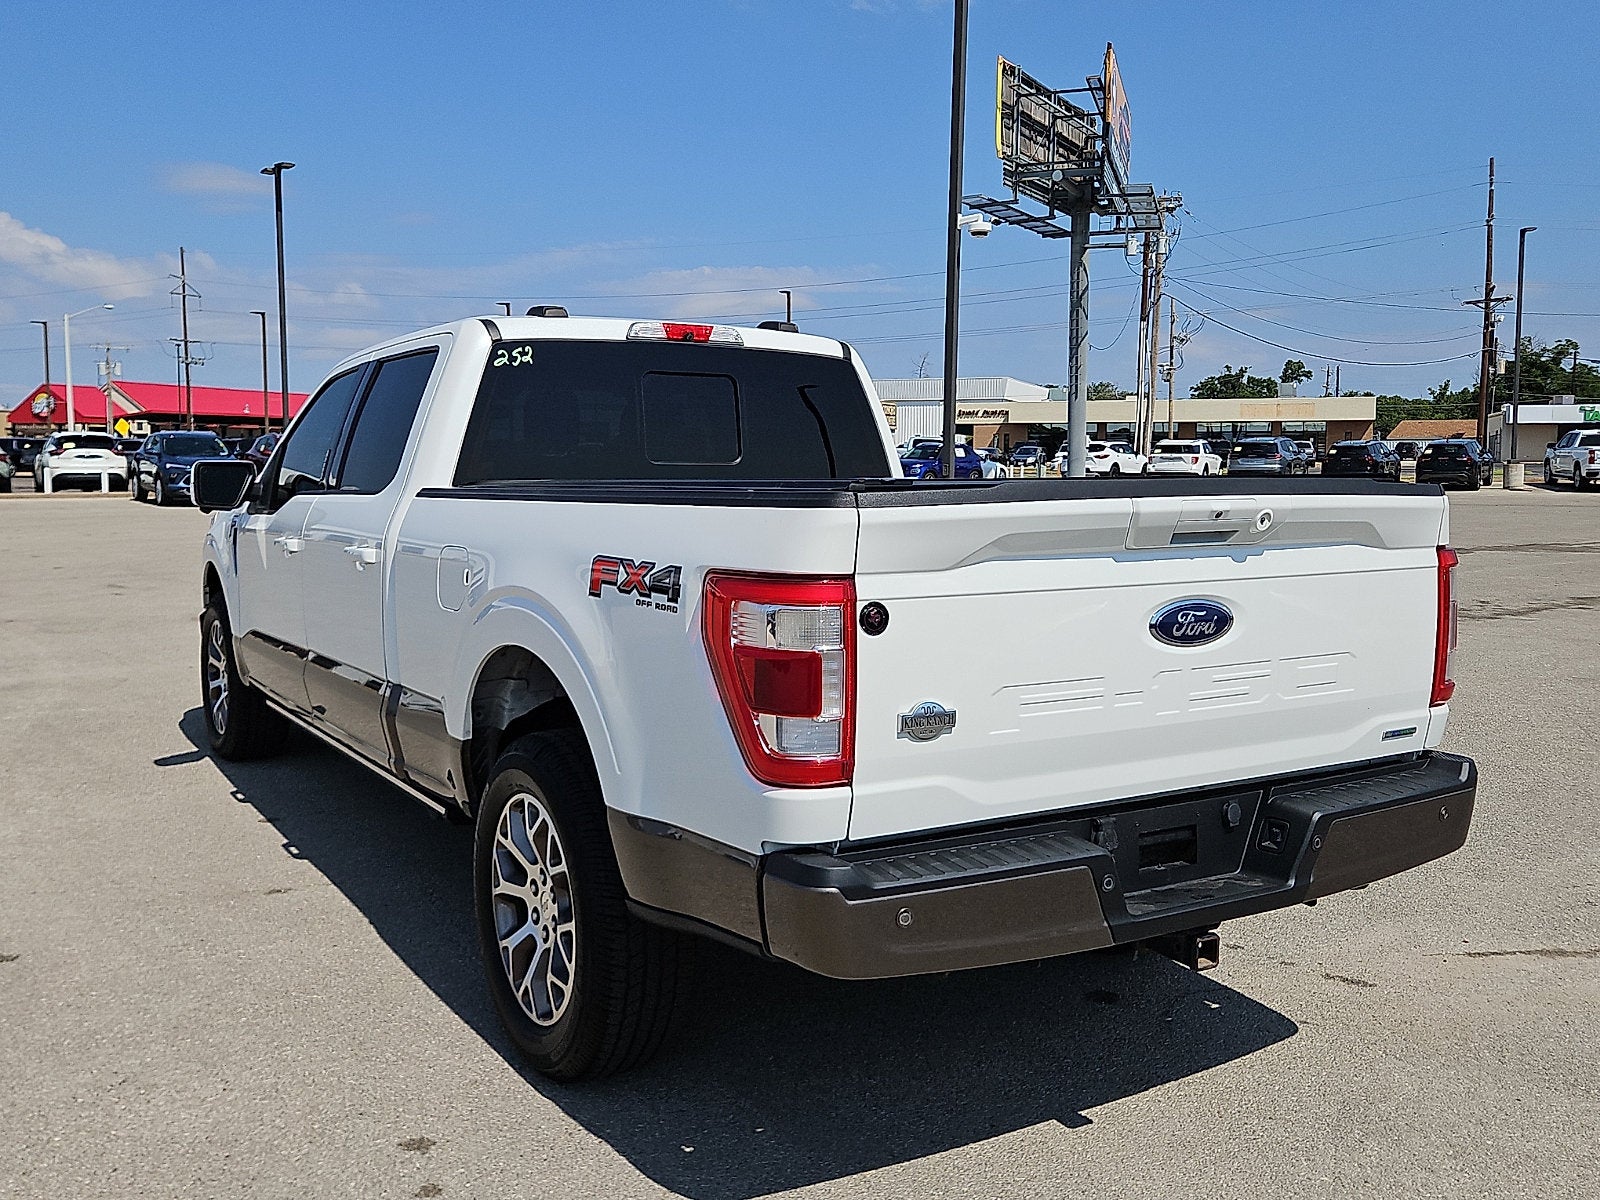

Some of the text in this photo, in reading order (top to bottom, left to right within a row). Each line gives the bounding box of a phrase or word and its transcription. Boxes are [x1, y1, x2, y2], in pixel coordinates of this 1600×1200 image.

[493, 345, 533, 367] 252
[588, 554, 683, 604] FX4
[635, 598, 679, 614] OFF ROAD
[1172, 610, 1218, 637] Ford
[989, 651, 1357, 735] F-150
[904, 713, 954, 729] KING RANCH
